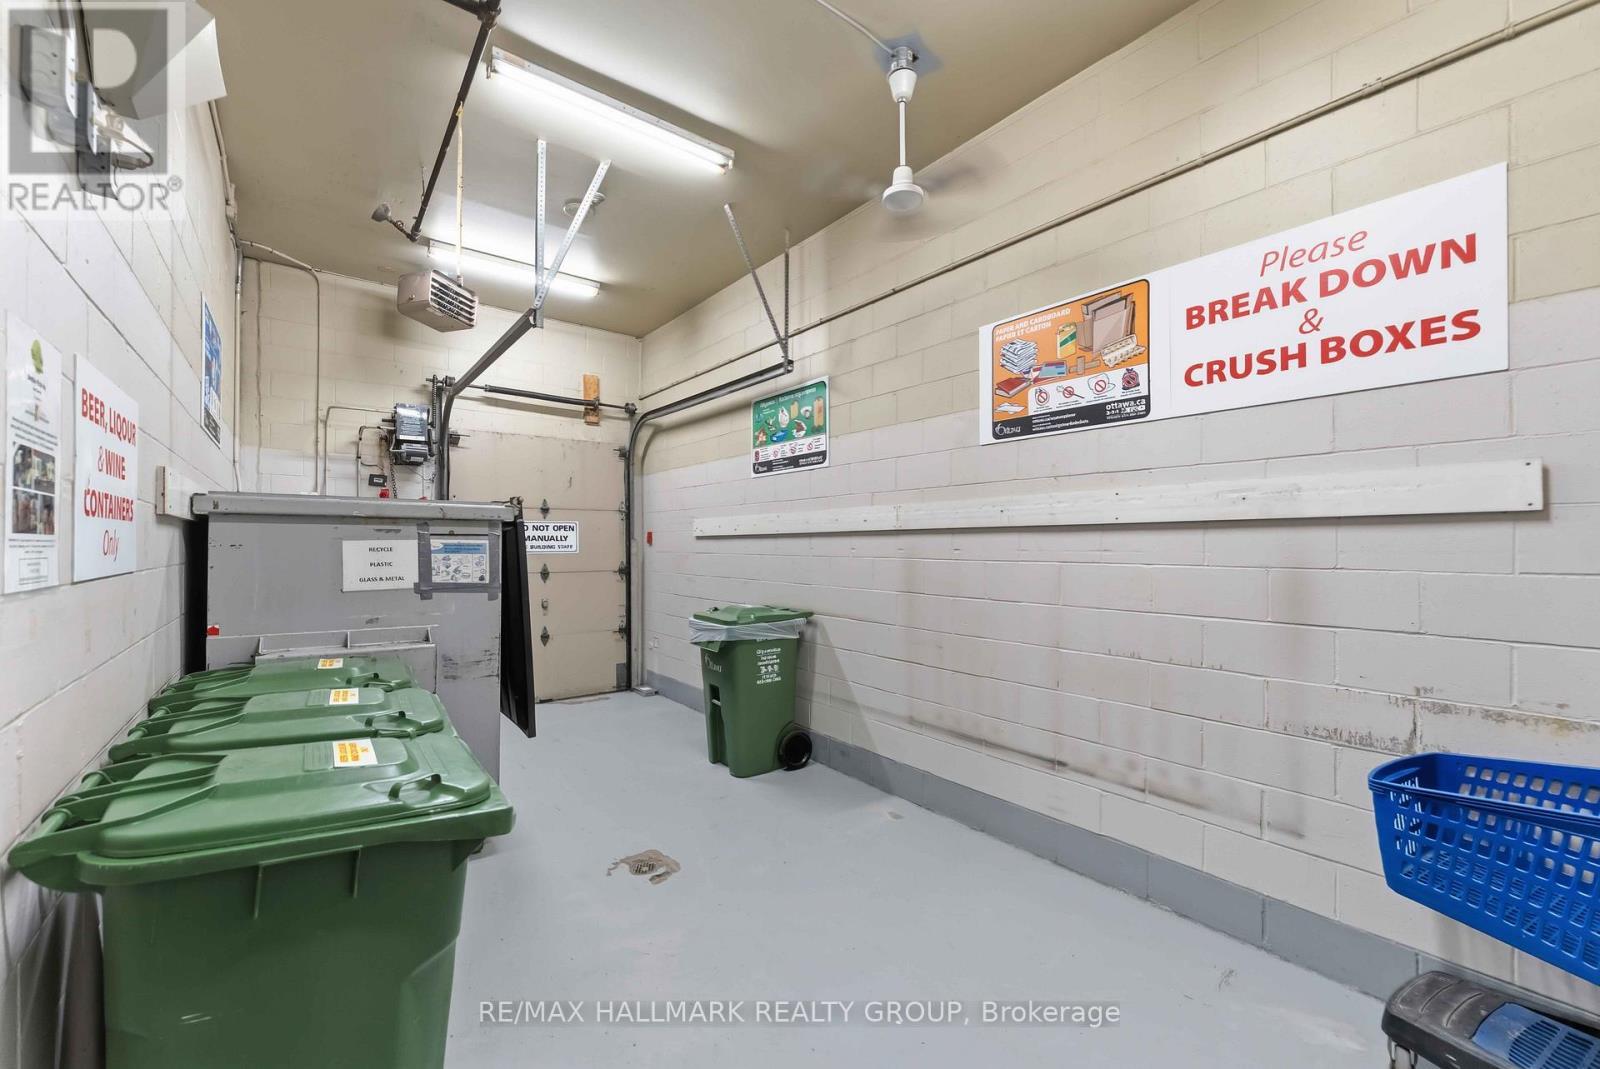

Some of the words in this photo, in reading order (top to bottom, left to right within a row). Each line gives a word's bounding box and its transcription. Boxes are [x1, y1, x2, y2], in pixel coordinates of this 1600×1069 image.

[1260, 230, 1368, 277] Please
[1185, 277, 1308, 331] BREAK
[1318, 232, 1478, 298] DOWN
[1299, 308, 1324, 335] &
[1184, 342, 1307, 388] CRUSH
[1320, 309, 1482, 364] BOXES
[81, 387, 109, 433] BEER,
[109, 407, 136, 447] LIQOUR
[1105, 398, 1147, 411] ottawa.ca
[97, 446, 104, 472] &
[105, 447, 126, 480] WINE
[83, 487, 134, 522] CONTAINERS
[532, 524, 550, 532] NOT
[552, 524, 575, 532] OPEN
[103, 529, 120, 562] Only
